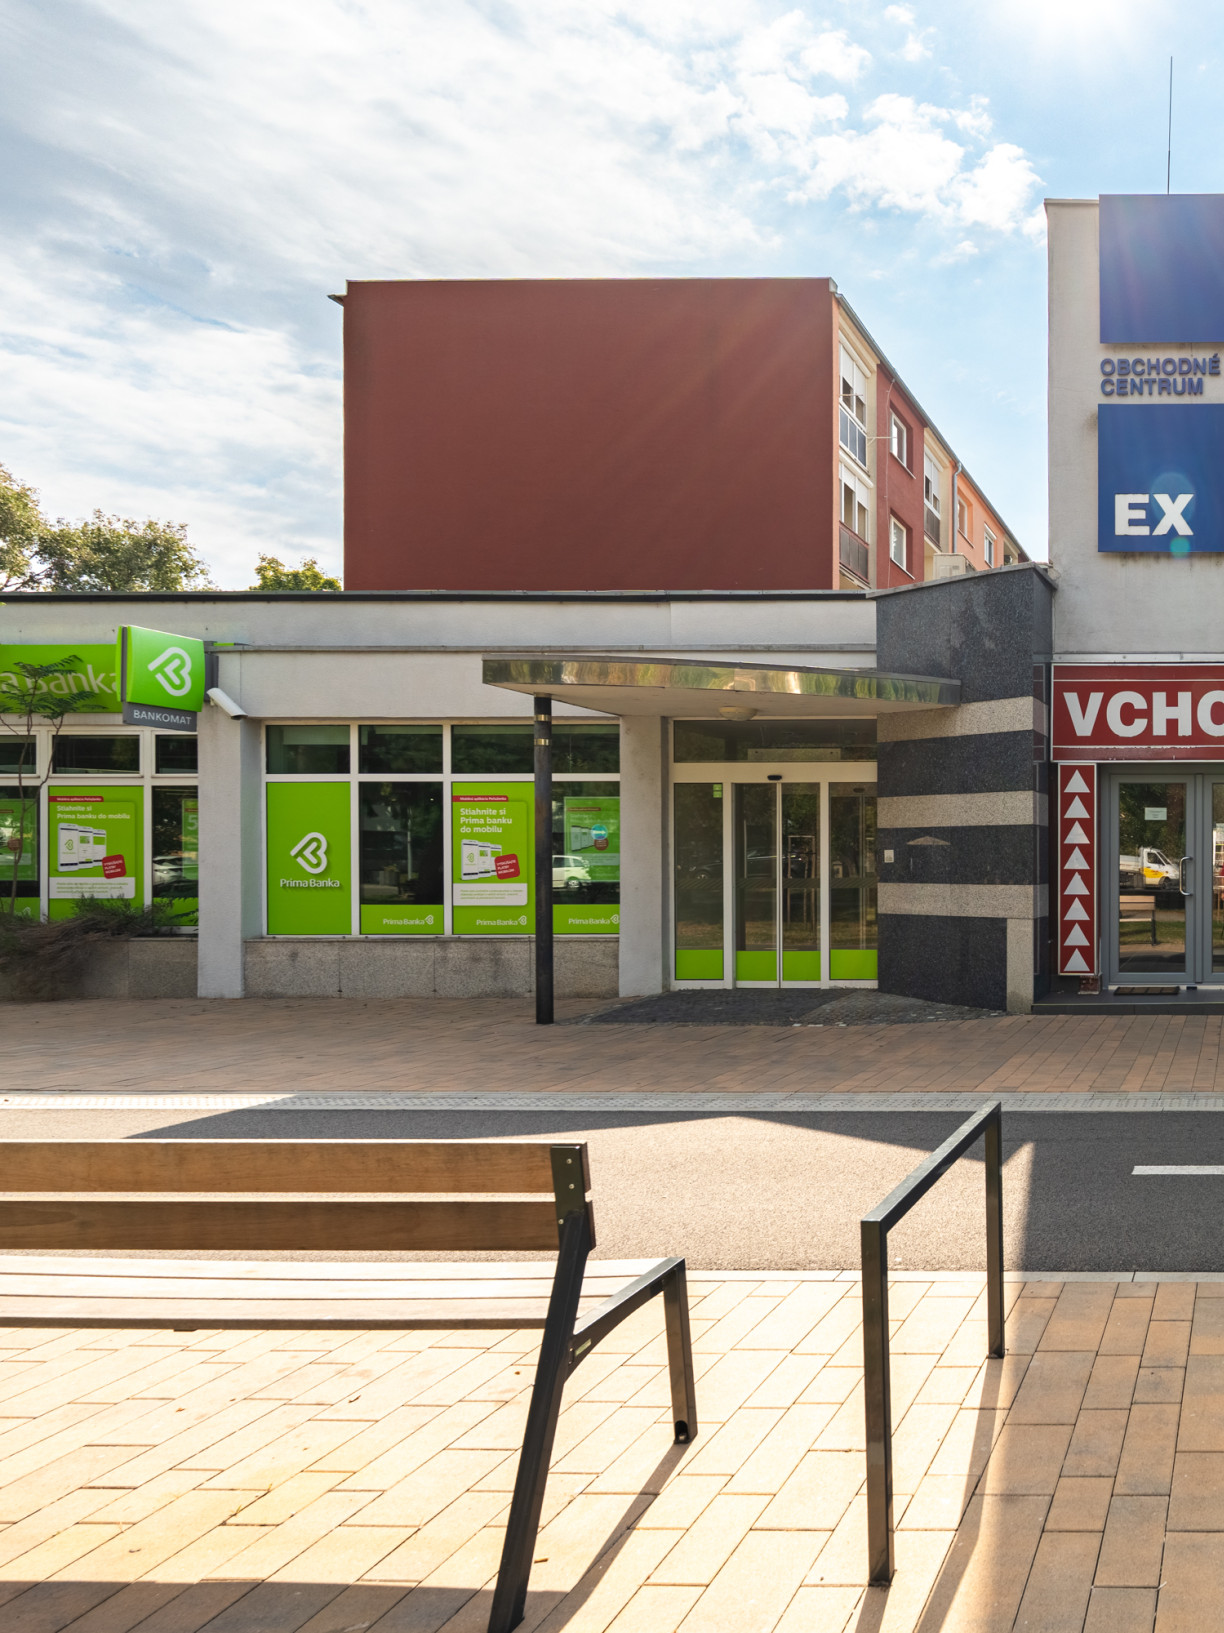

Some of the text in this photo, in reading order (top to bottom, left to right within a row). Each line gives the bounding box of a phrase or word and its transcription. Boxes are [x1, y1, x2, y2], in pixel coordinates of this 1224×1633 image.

[1100, 354, 1221, 376] OBCHODNÉ
[1100, 377, 1204, 396] CENTRUM
[1114, 493, 1195, 536] EX
[133, 709, 192, 726] BANKOMAT
[460, 807, 507, 816] Stiahnite si
[460, 816, 513, 825] Prima banku
[460, 825, 503, 834] do mobilu
[279, 877, 340, 888] Prima Banka
[403, 917, 425, 925] Banka
